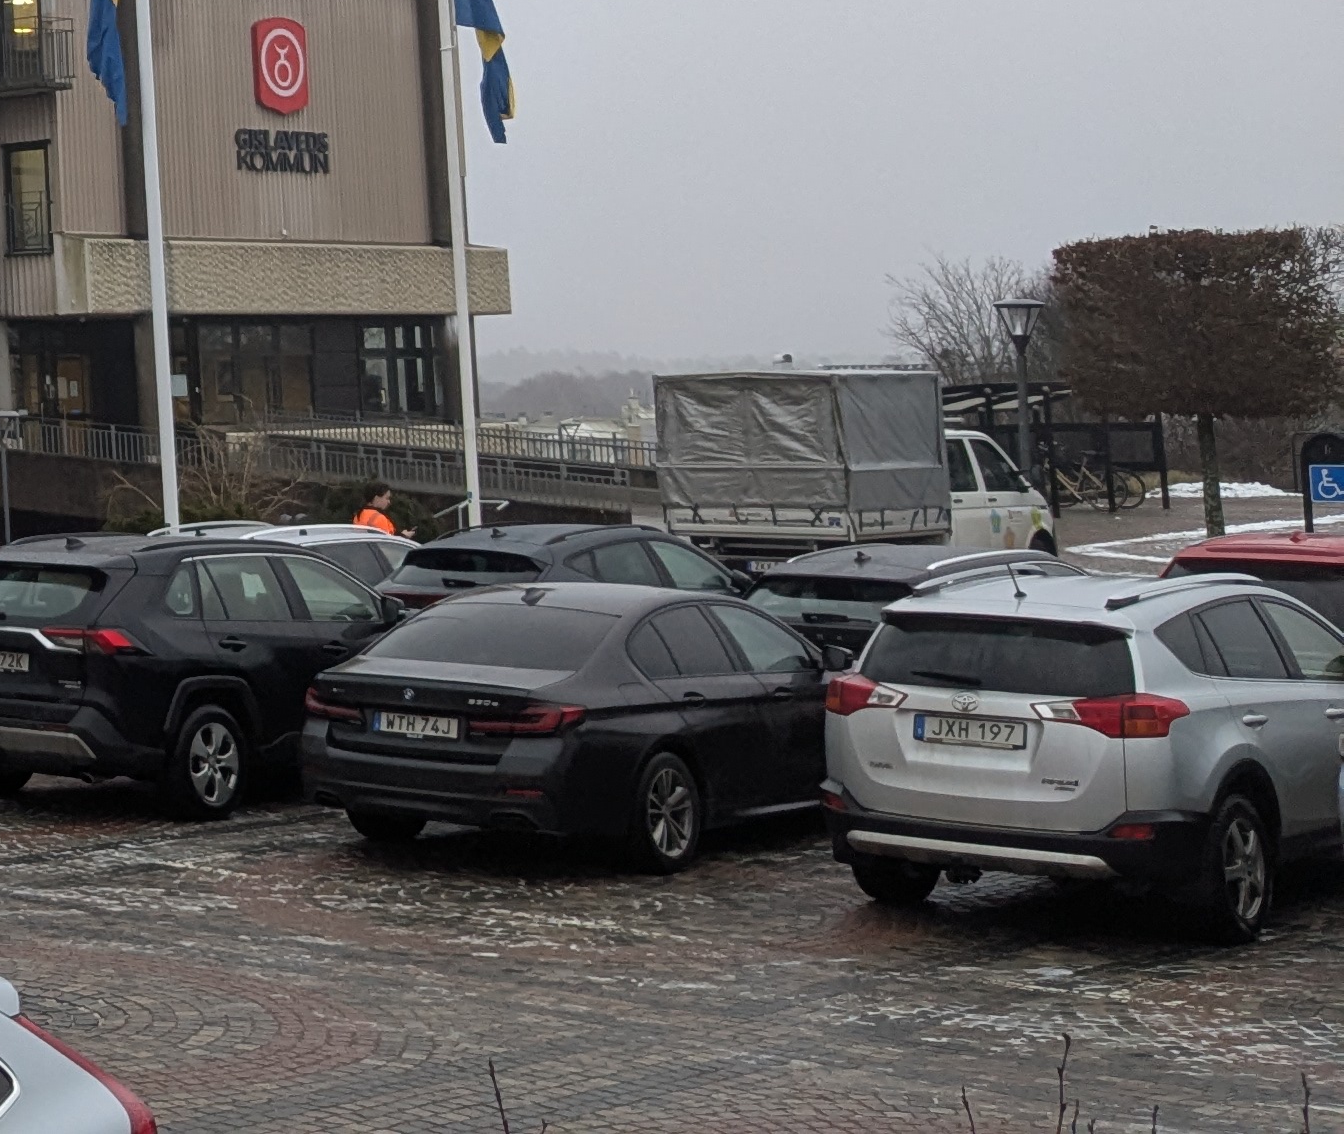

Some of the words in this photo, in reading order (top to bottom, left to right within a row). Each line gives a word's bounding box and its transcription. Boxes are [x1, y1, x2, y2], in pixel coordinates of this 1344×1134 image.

[234, 128, 329, 153] GISLAVEDS
[236, 149, 330, 174] KOMMUN
[0, 652, 24, 669] 72K
[386, 714, 416, 732] WTH
[420, 716, 451, 735] 74J
[931, 718, 970, 739] JXH
[978, 722, 1016, 742] 197
